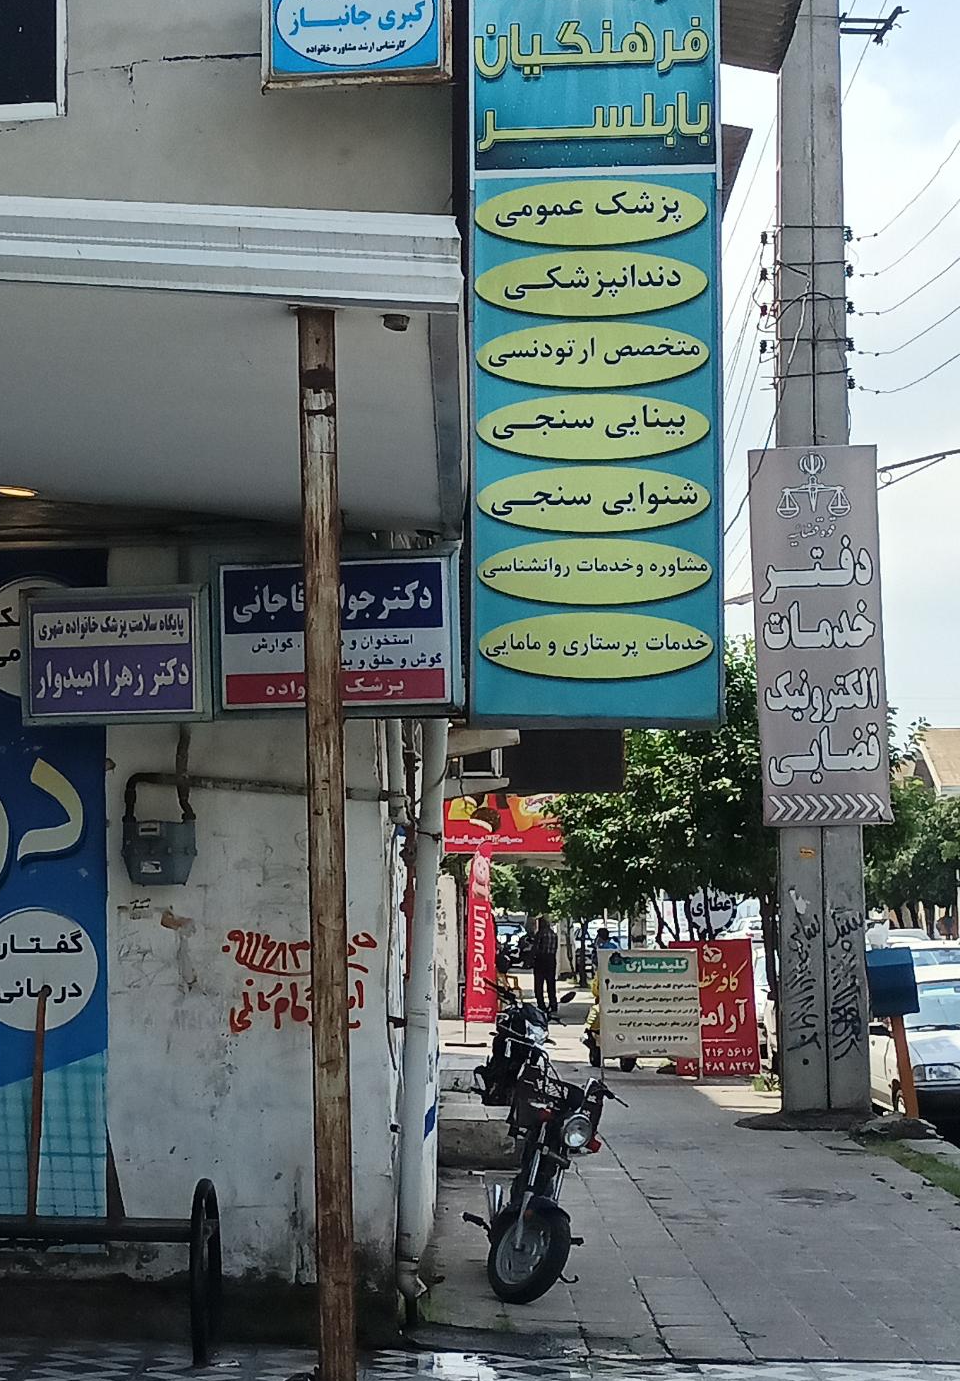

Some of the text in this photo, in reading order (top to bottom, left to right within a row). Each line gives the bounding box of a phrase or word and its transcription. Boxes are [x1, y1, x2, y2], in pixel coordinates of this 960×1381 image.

[288, 0, 426, 36] کبری جانباز
[305, 39, 407, 55] کارشناسی ارشد مشاوره خانواده
[474, 16, 709, 79] فرهنگیان
[476, 92, 711, 151] بابلسر
[495, 191, 682, 227] پزشک عمومی
[504, 264, 681, 299] دندانپزشکی
[488, 336, 700, 367] متخصص ارتودنسی
[492, 404, 686, 439] بینایی سنجی
[490, 481, 698, 516] شنوایی سنجی
[483, 557, 570, 578] روانشناسی
[649, 557, 709, 578] مشاوره
[760, 535, 873, 604] دفتر
[233, 580, 433, 623] دکتر جوا قاجانی
[38, 613, 185, 641] پایگاه سلامت پزشک خانواده شهری
[763, 599, 876, 650] خدمات
[349, 640, 357, 651] و
[360, 634, 414, 649] استخوان
[485, 633, 709, 657] خدمات پرستاری و مامایی
[357, 659, 365, 669] و
[368, 654, 394, 669] حلق
[400, 659, 407, 669] و
[410, 653, 442, 668] گوش
[36, 657, 189, 699] دکتر زهرا امیدوار
[345, 677, 404, 697] پزشک
[765, 667, 880, 723] الکترونیک
[768, 722, 881, 787] قضایی
[625, 959, 688, 973] کلید سازی
[700, 998, 748, 1034] آرام
